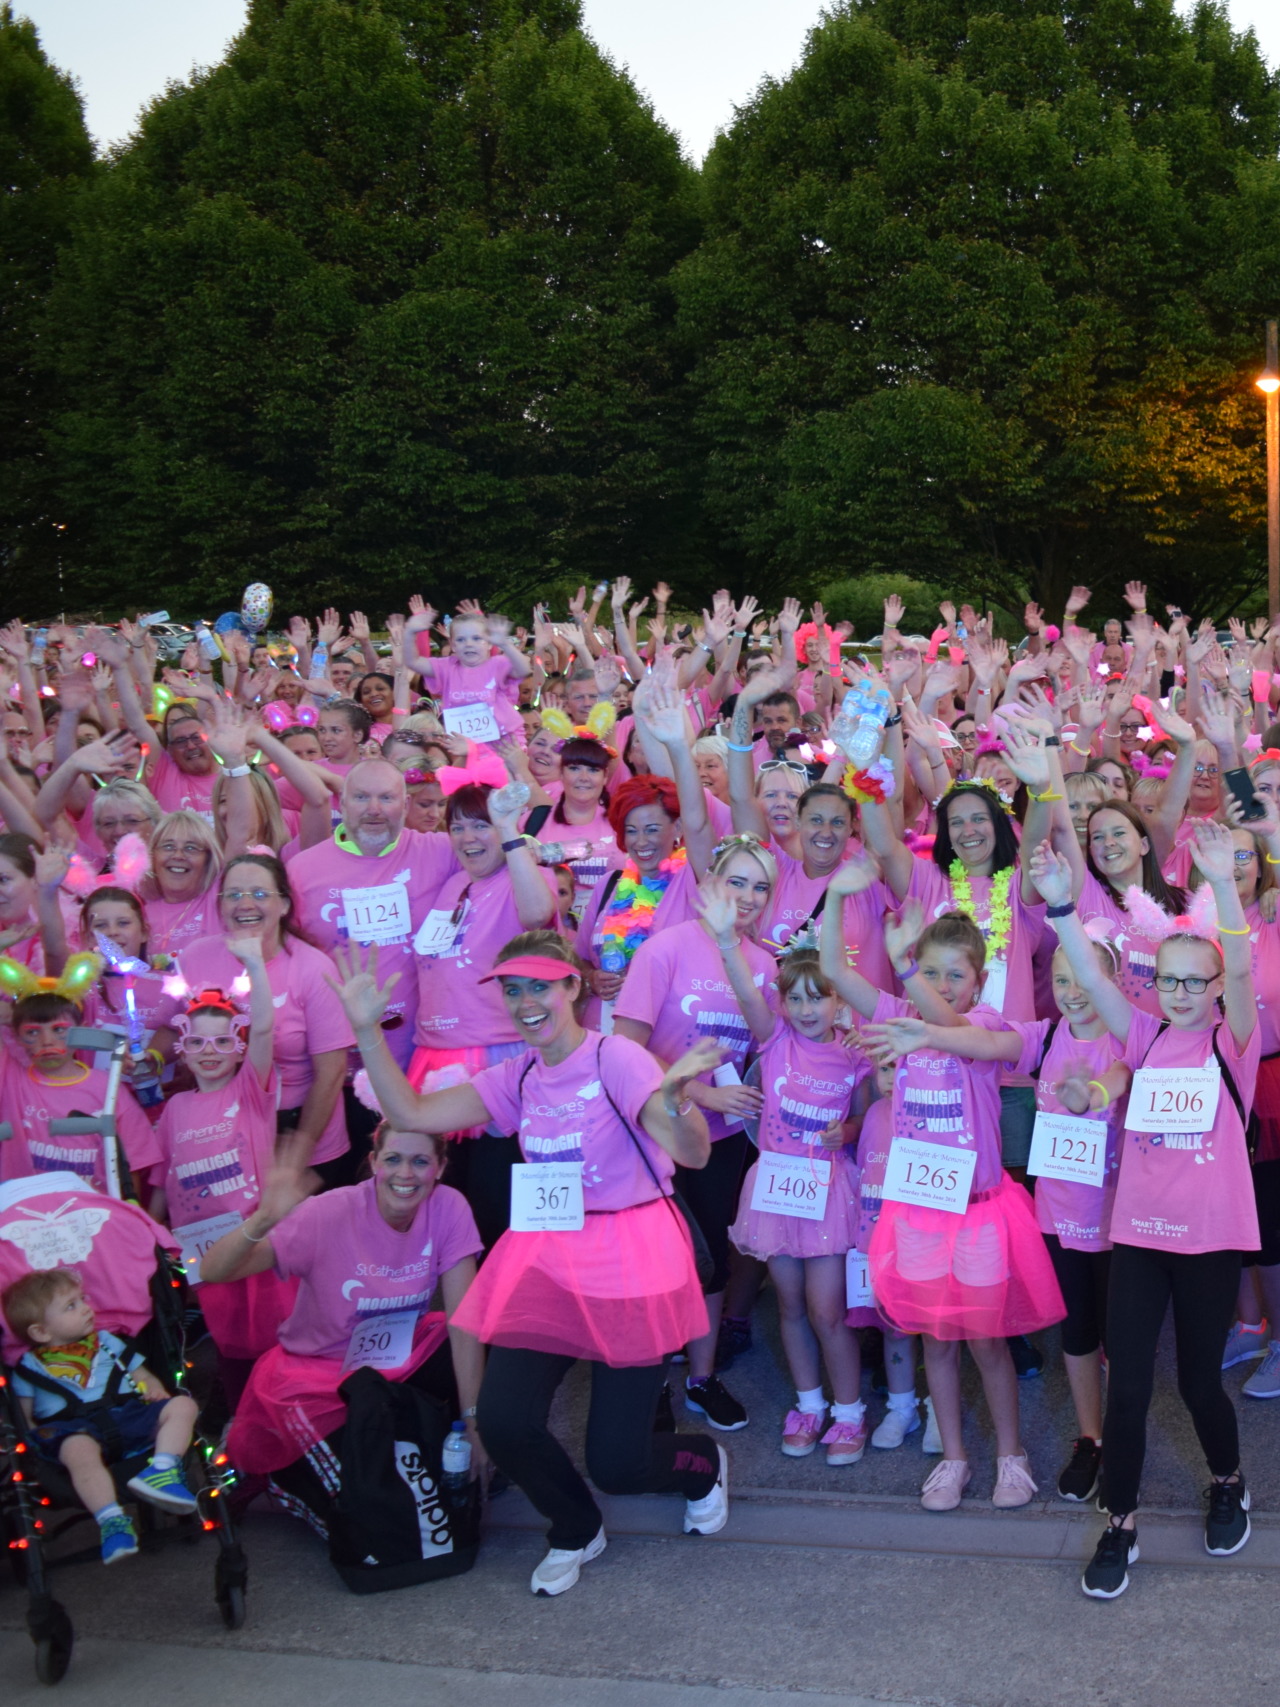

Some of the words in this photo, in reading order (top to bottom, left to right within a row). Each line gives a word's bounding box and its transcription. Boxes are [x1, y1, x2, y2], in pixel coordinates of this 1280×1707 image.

[458, 716, 490, 734] 1329
[353, 902, 400, 926] 1124
[691, 979, 702, 990] St
[1141, 1076, 1173, 1088] Moonlight
[1175, 1076, 1183, 1084] &
[1184, 1076, 1215, 1084] Memories
[904, 1087, 962, 1104] MOONLIGHT
[1148, 1090, 1204, 1113] 1206
[781, 1096, 842, 1122] MOONLIGHT
[926, 1116, 965, 1132] WALK
[1043, 1122, 1074, 1133] Moonlight
[1142, 1117, 1165, 1125] Saturday
[1049, 1136, 1098, 1166] 1221
[1164, 1132, 1204, 1150] WALK
[176, 1148, 240, 1180] MOONLIGHT
[899, 1146, 930, 1160] Moonlight
[941, 1153, 970, 1166] Memories
[904, 1162, 959, 1191] 1265
[208, 1177, 248, 1197] WALK
[768, 1174, 818, 1200] 1408
[535, 1186, 570, 1210] 367
[1076, 1226, 1100, 1234] IMAGE
[1131, 1218, 1153, 1228] SMART
[1164, 1224, 1188, 1232] IMAGE
[1137, 1228, 1182, 1238] WORKWEAR
[353, 1332, 392, 1356] 350
[401, 1452, 453, 1546] adidas
